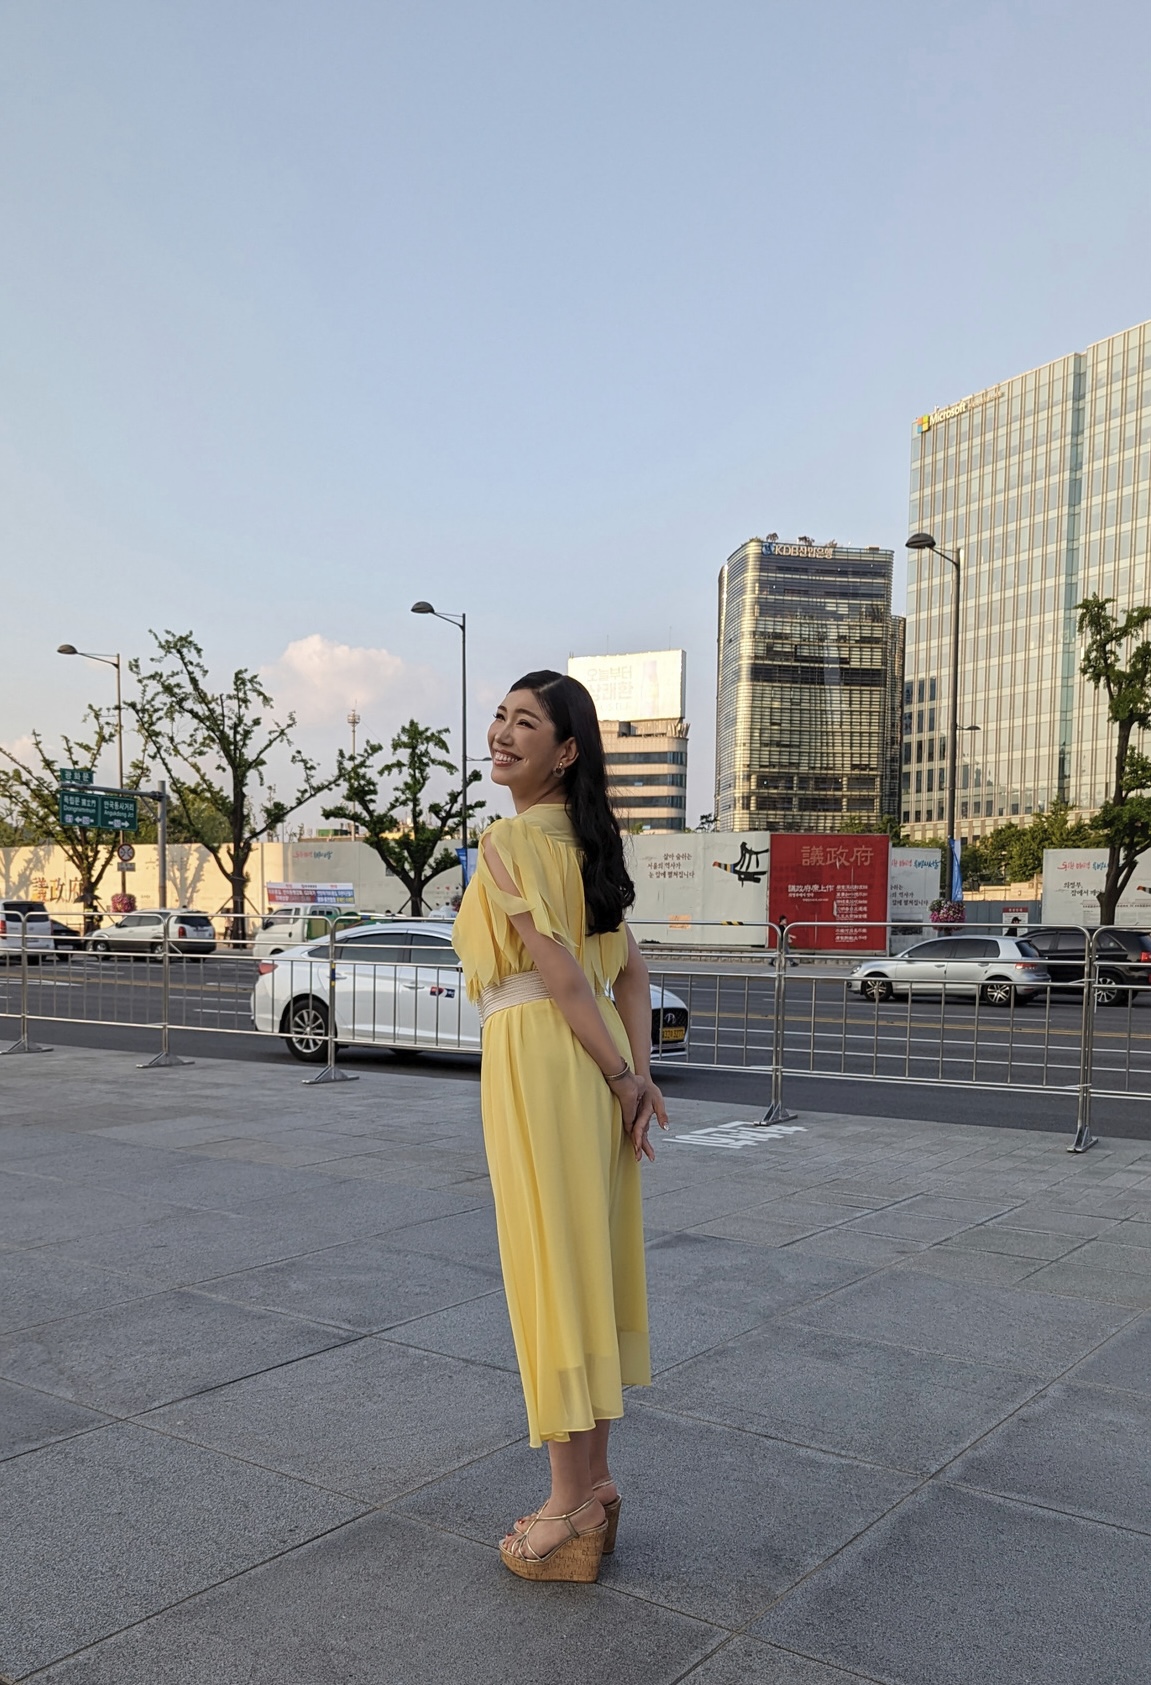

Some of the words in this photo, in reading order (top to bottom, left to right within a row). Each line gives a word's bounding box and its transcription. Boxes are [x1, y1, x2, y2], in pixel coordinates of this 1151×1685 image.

[929, 402, 967, 426] Microsoft
[64, 770, 90, 782] 광화문
[801, 845, 875, 867] 議政府
